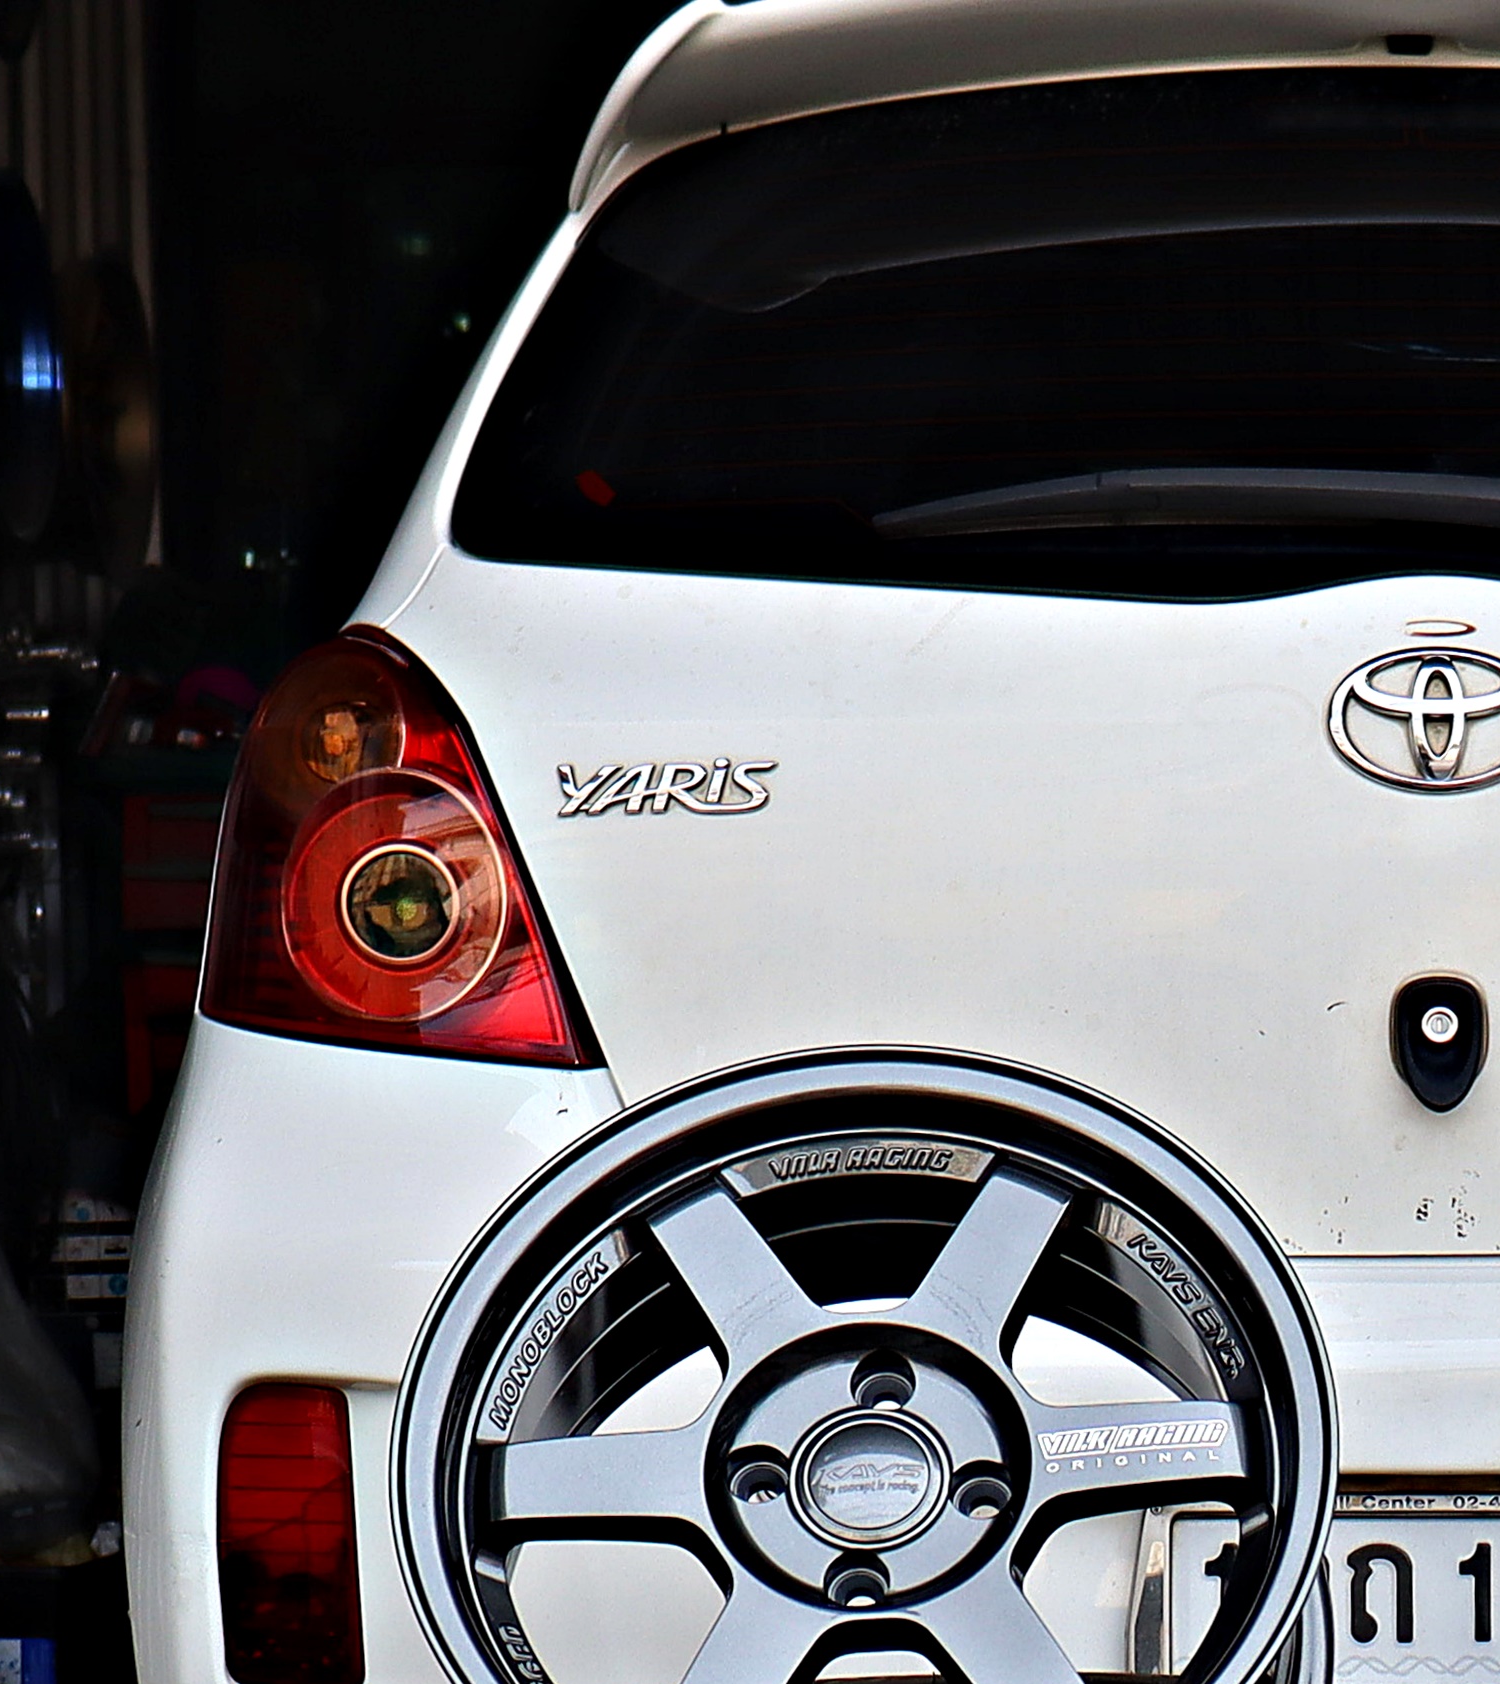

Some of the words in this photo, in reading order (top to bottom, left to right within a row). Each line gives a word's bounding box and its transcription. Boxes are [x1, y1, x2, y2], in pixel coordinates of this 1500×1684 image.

[489, 1251, 609, 1431] MONOBLOCK
[1045, 1449, 1220, 1474] ORIGINAL
[1361, 1495, 1436, 1511] Center
